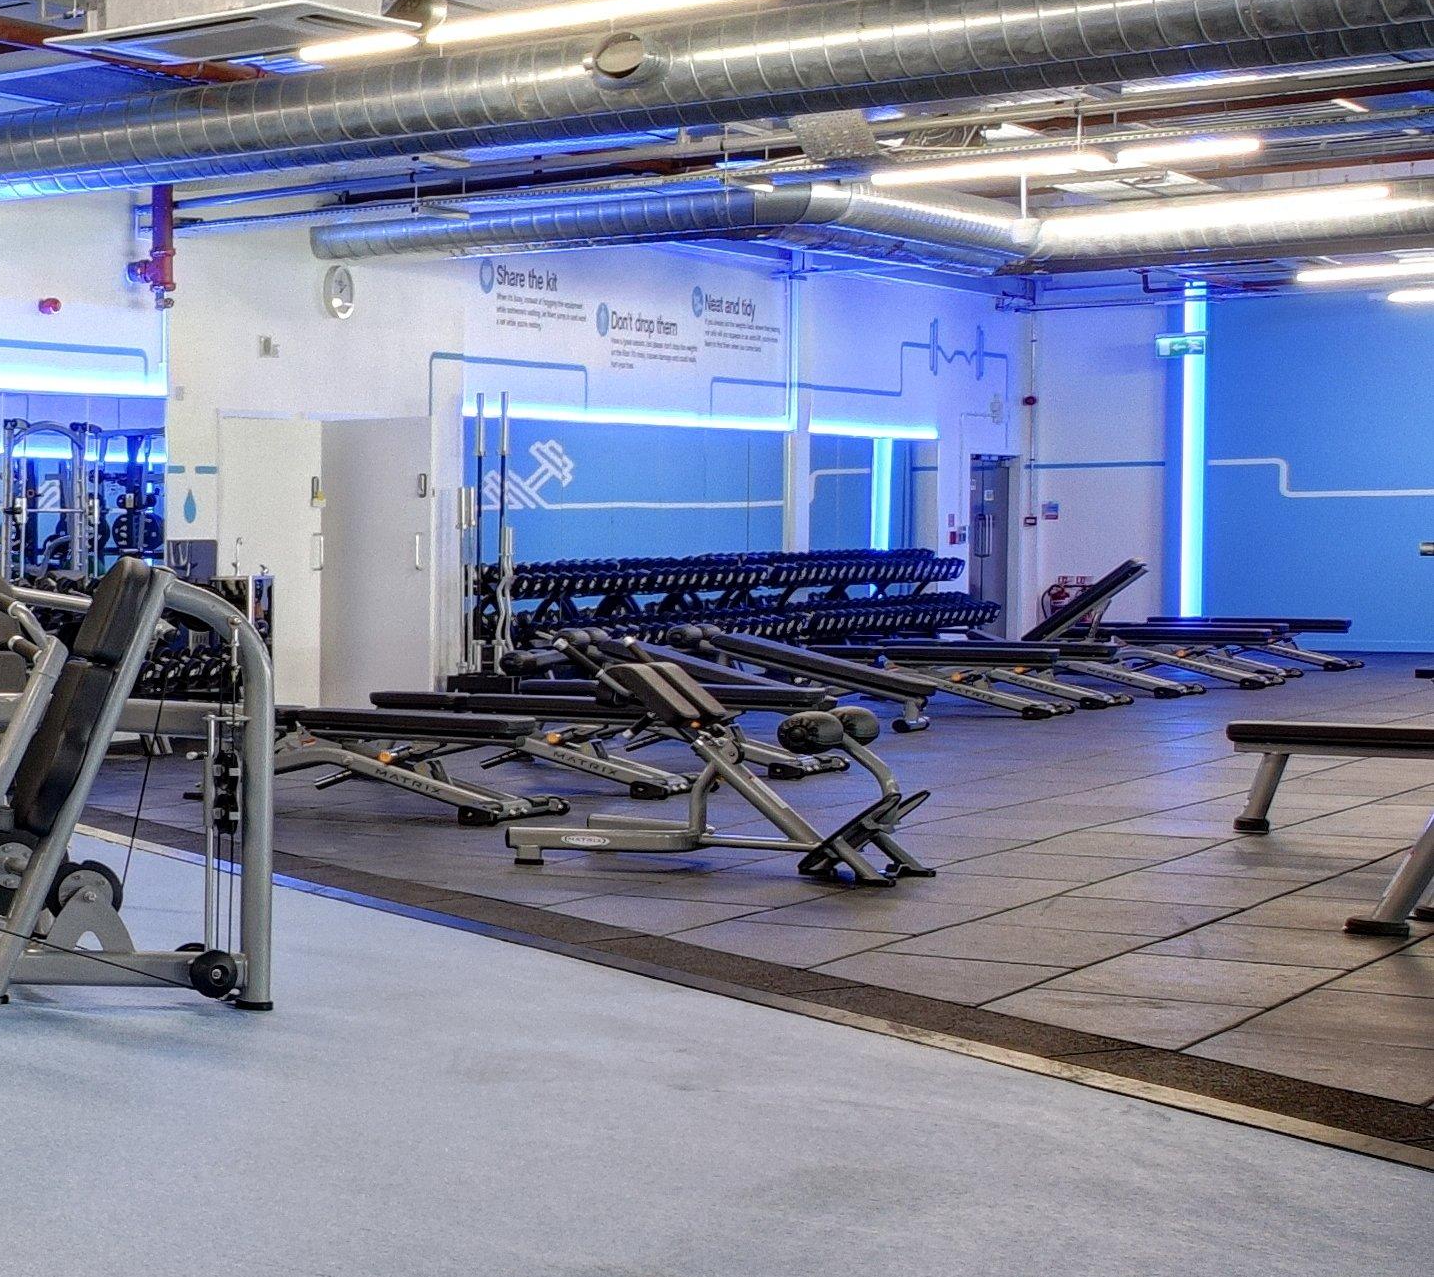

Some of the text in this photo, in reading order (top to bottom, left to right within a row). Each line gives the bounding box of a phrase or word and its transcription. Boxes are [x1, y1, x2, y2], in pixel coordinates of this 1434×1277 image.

[496, 265, 558, 292] Share the kit
[704, 294, 756, 322] Neat and tidy
[611, 311, 633, 330] Don't
[635, 313, 655, 338] drop
[657, 315, 678, 336] them
[552, 749, 619, 777] MATRIX
[374, 766, 441, 796] MATRIX
